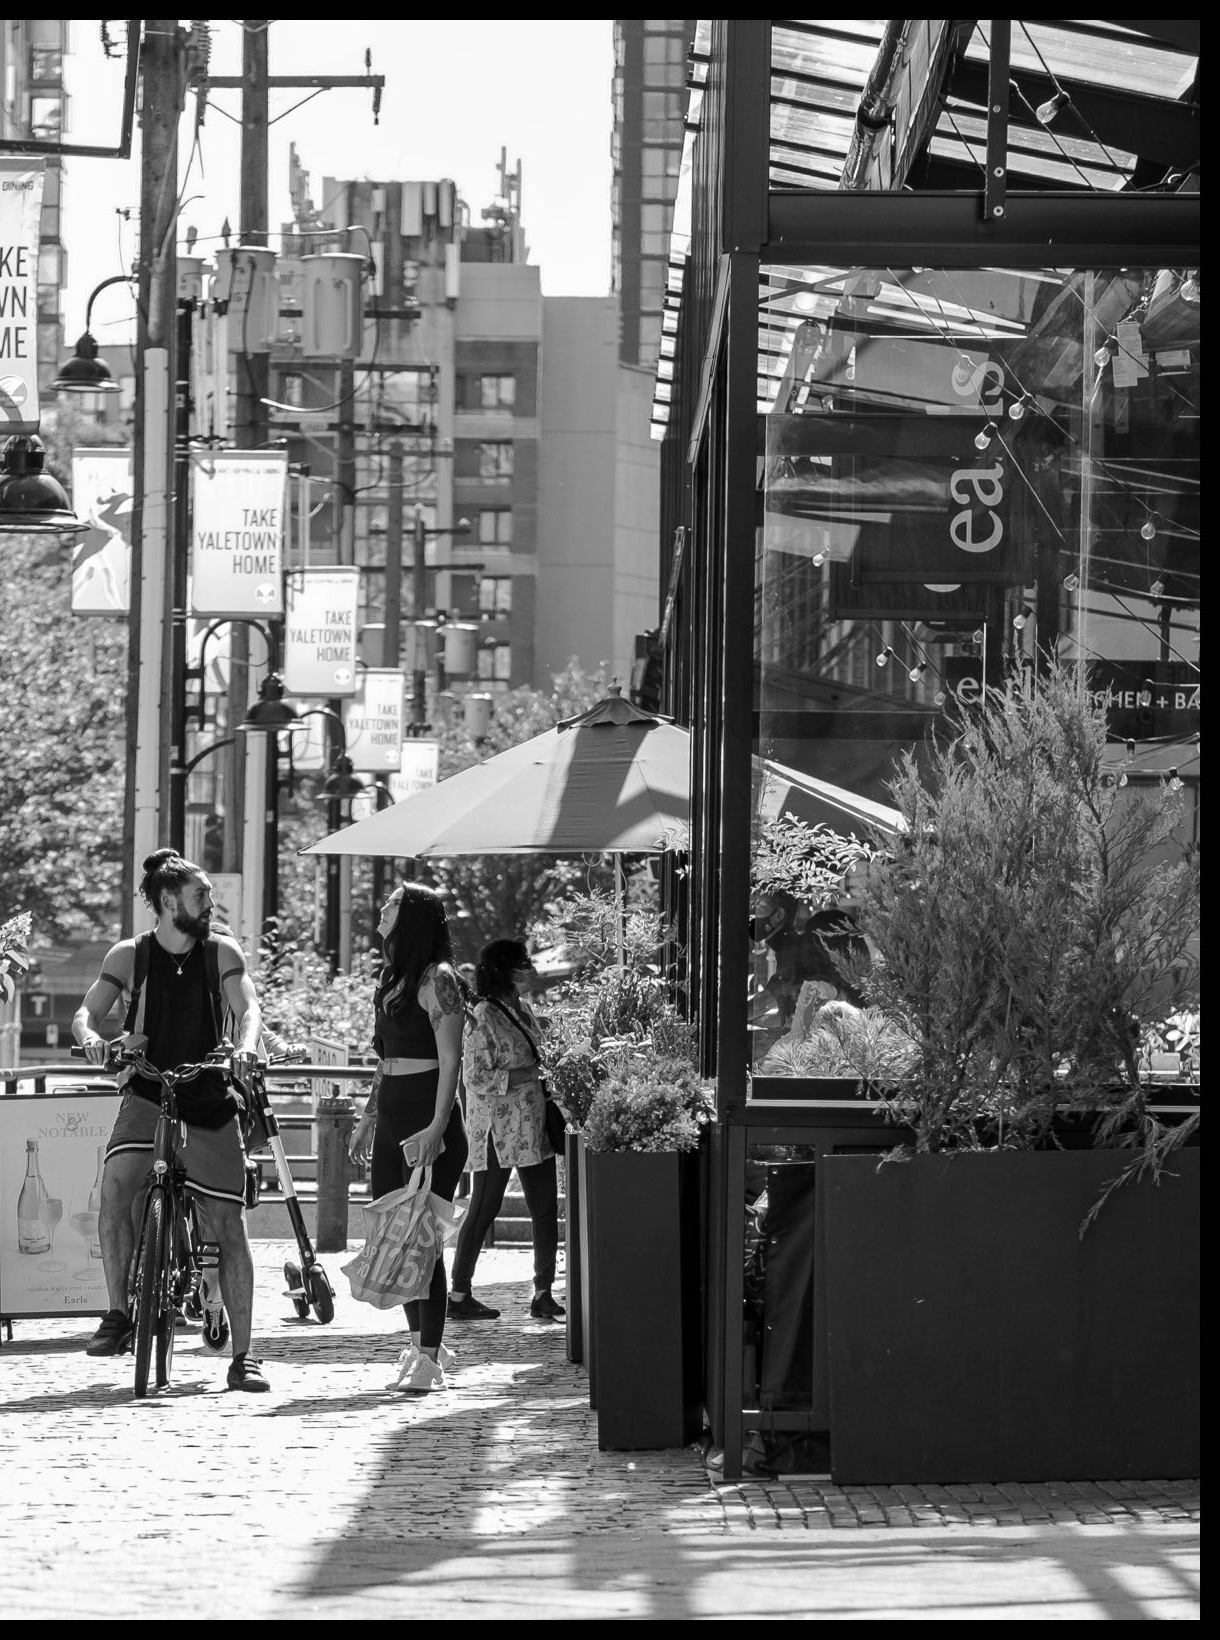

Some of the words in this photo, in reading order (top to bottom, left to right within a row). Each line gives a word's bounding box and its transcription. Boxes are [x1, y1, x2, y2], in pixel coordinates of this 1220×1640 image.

[2, 181, 34, 191] DINING
[242, 508, 277, 527] TAKE
[198, 531, 277, 550] YALETOWN
[233, 555, 276, 574] HOME
[325, 610, 352, 625] TAKE
[290, 628, 352, 644] YALETOWN
[316, 646, 351, 662] HOME
[377, 703, 398, 715] TAKE
[348, 719, 399, 731] YALETOWN
[370, 733, 398, 745] HOME
[56, 1112, 89, 1122] NEW
[39, 1127, 107, 1138] NOTABLE
[64, 1296, 89, 1304] Earls
